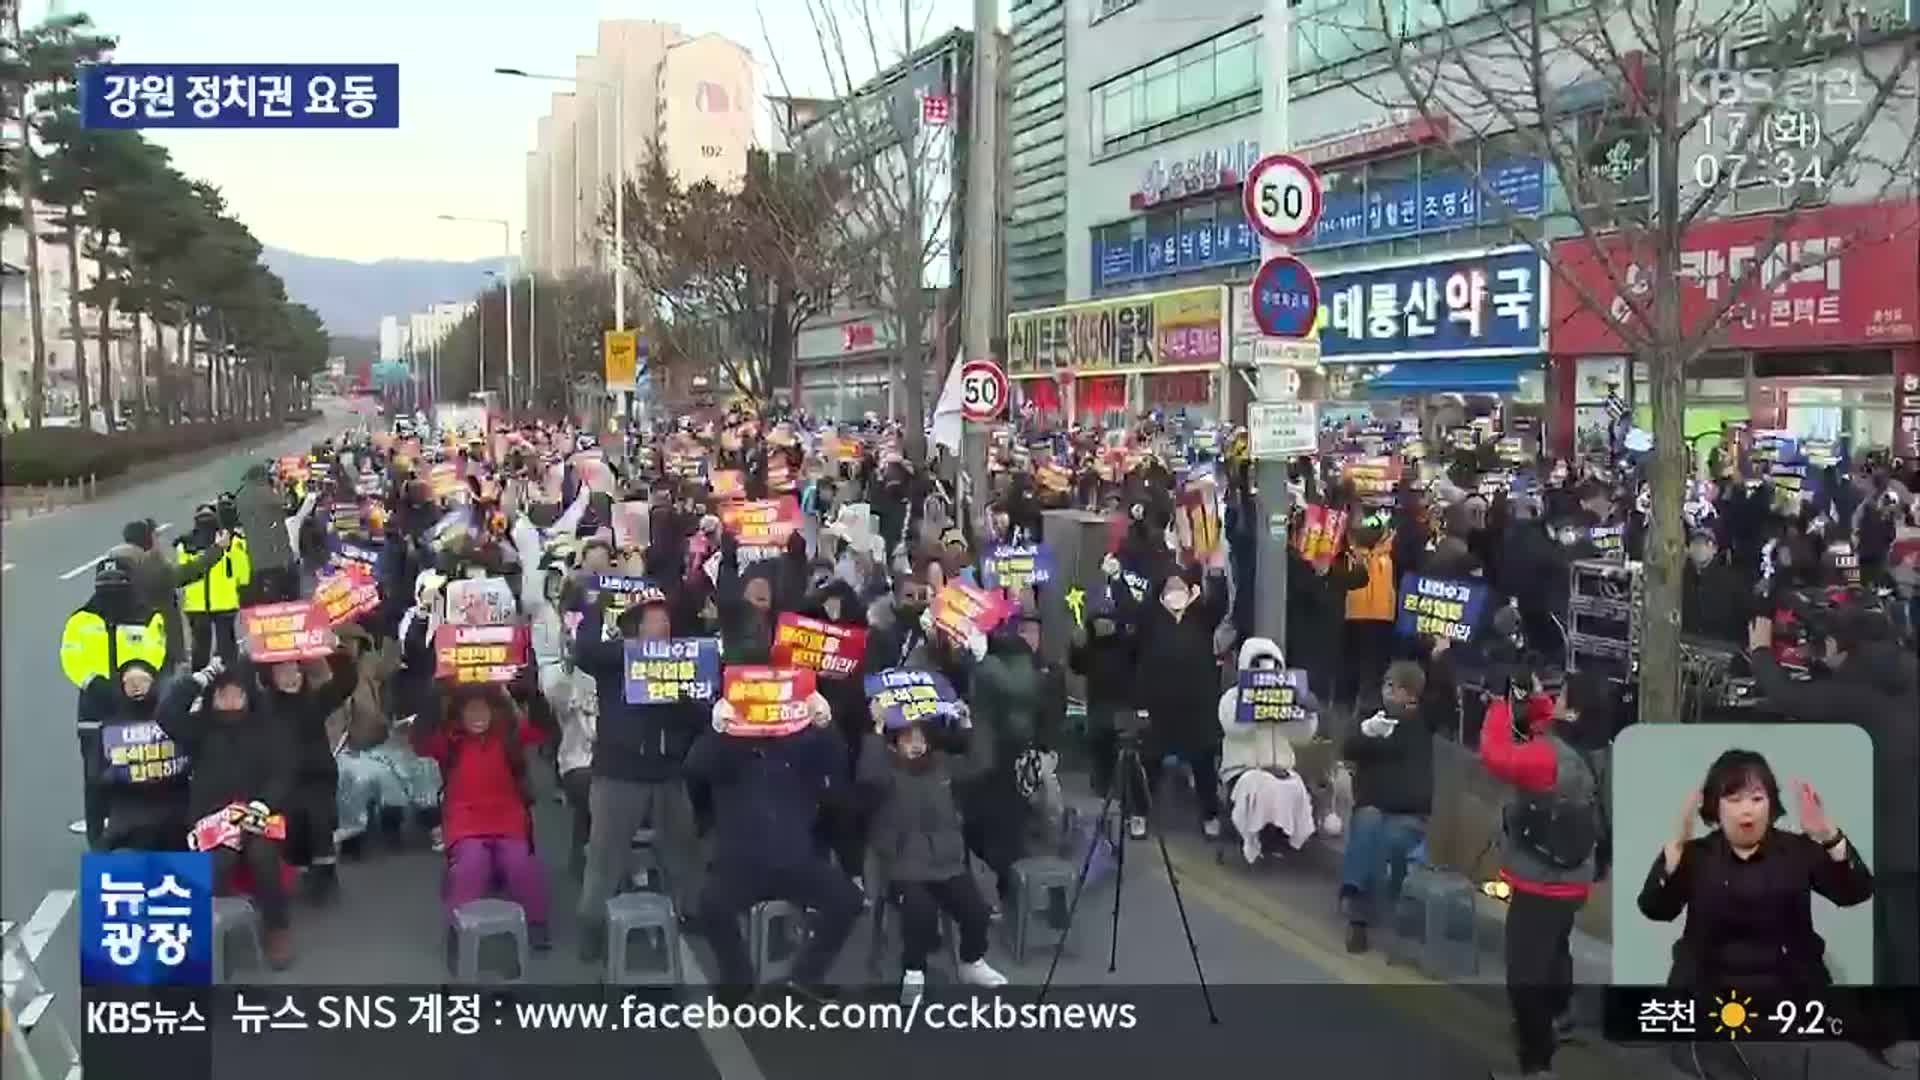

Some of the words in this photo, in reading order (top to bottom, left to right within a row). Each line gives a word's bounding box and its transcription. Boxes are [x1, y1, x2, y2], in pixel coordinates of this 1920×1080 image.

[701, 145, 724, 158] 102
[1261, 185, 1303, 219] 50
[965, 376, 997, 405] 50
